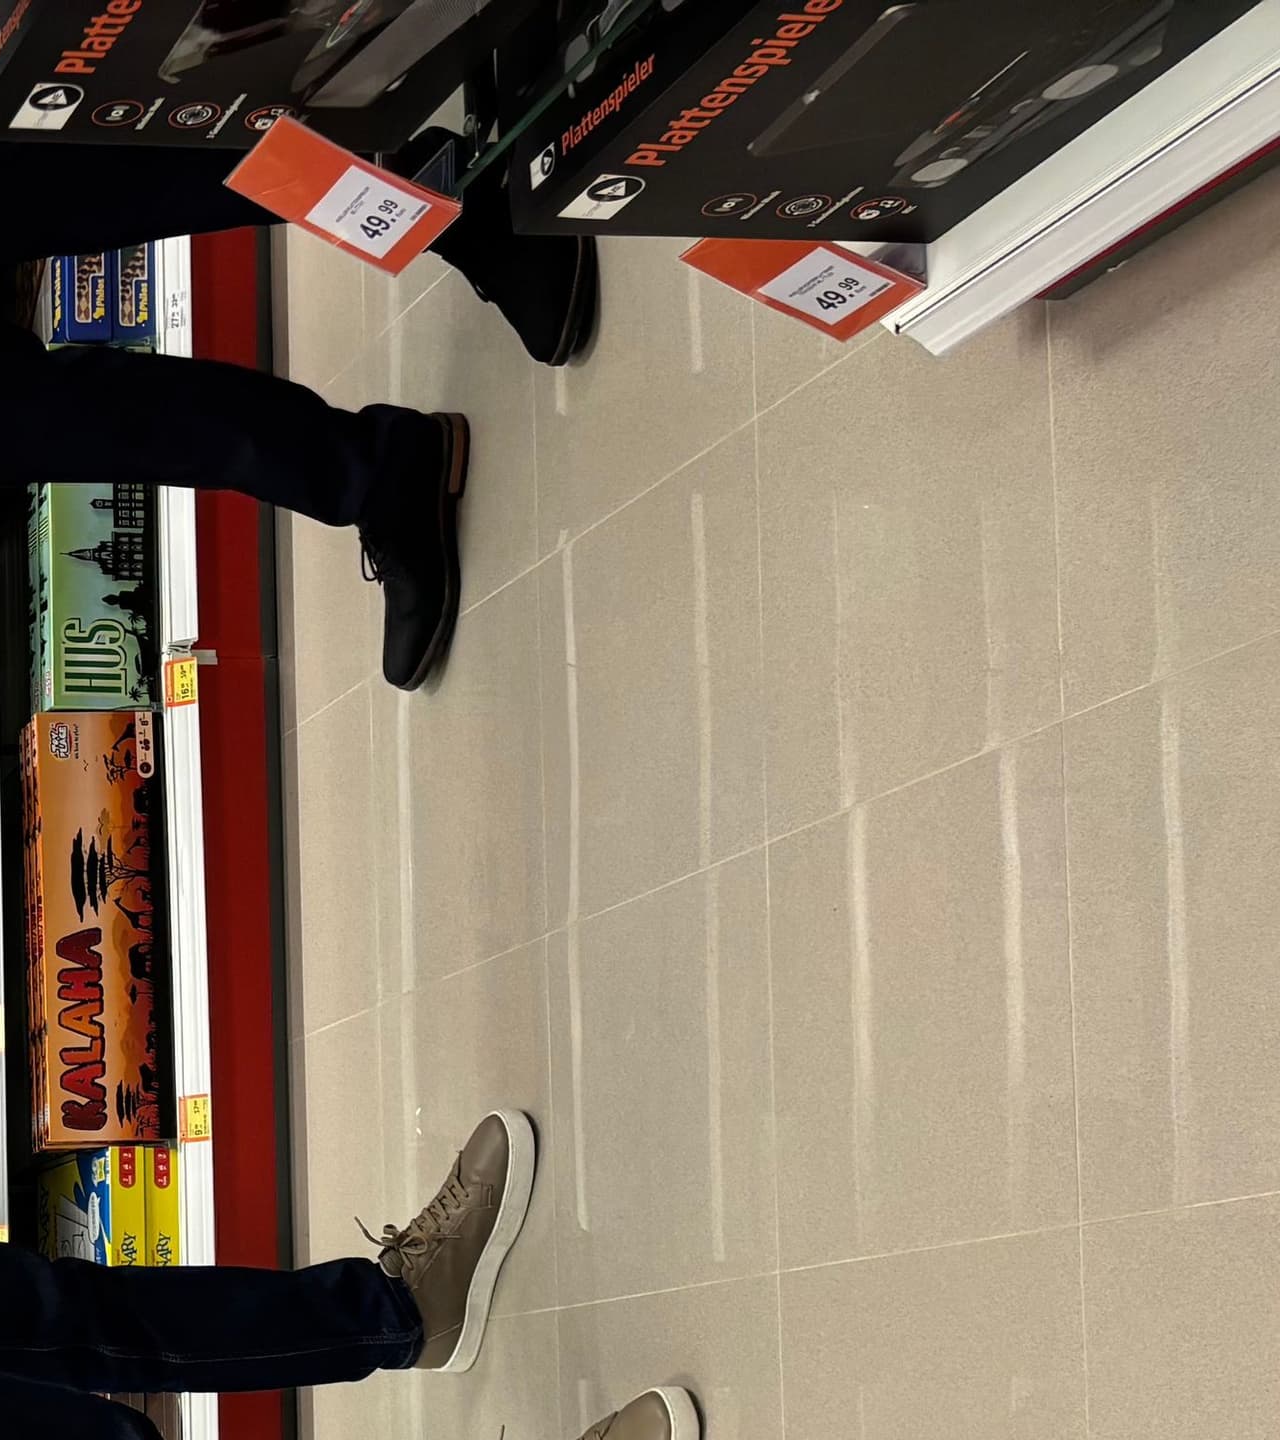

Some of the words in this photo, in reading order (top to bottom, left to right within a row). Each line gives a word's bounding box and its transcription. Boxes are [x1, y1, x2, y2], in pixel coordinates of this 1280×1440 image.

[54, 0, 142, 75] Platte
[560, 54, 657, 155] Plattenspieler
[623, 0, 844, 167] Plattenspiele
[358, 198, 399, 241] 49.99
[814, 277, 861, 311] 49.99
[60, 618, 127, 695] HUS
[55, 927, 108, 1131] KALAHA
